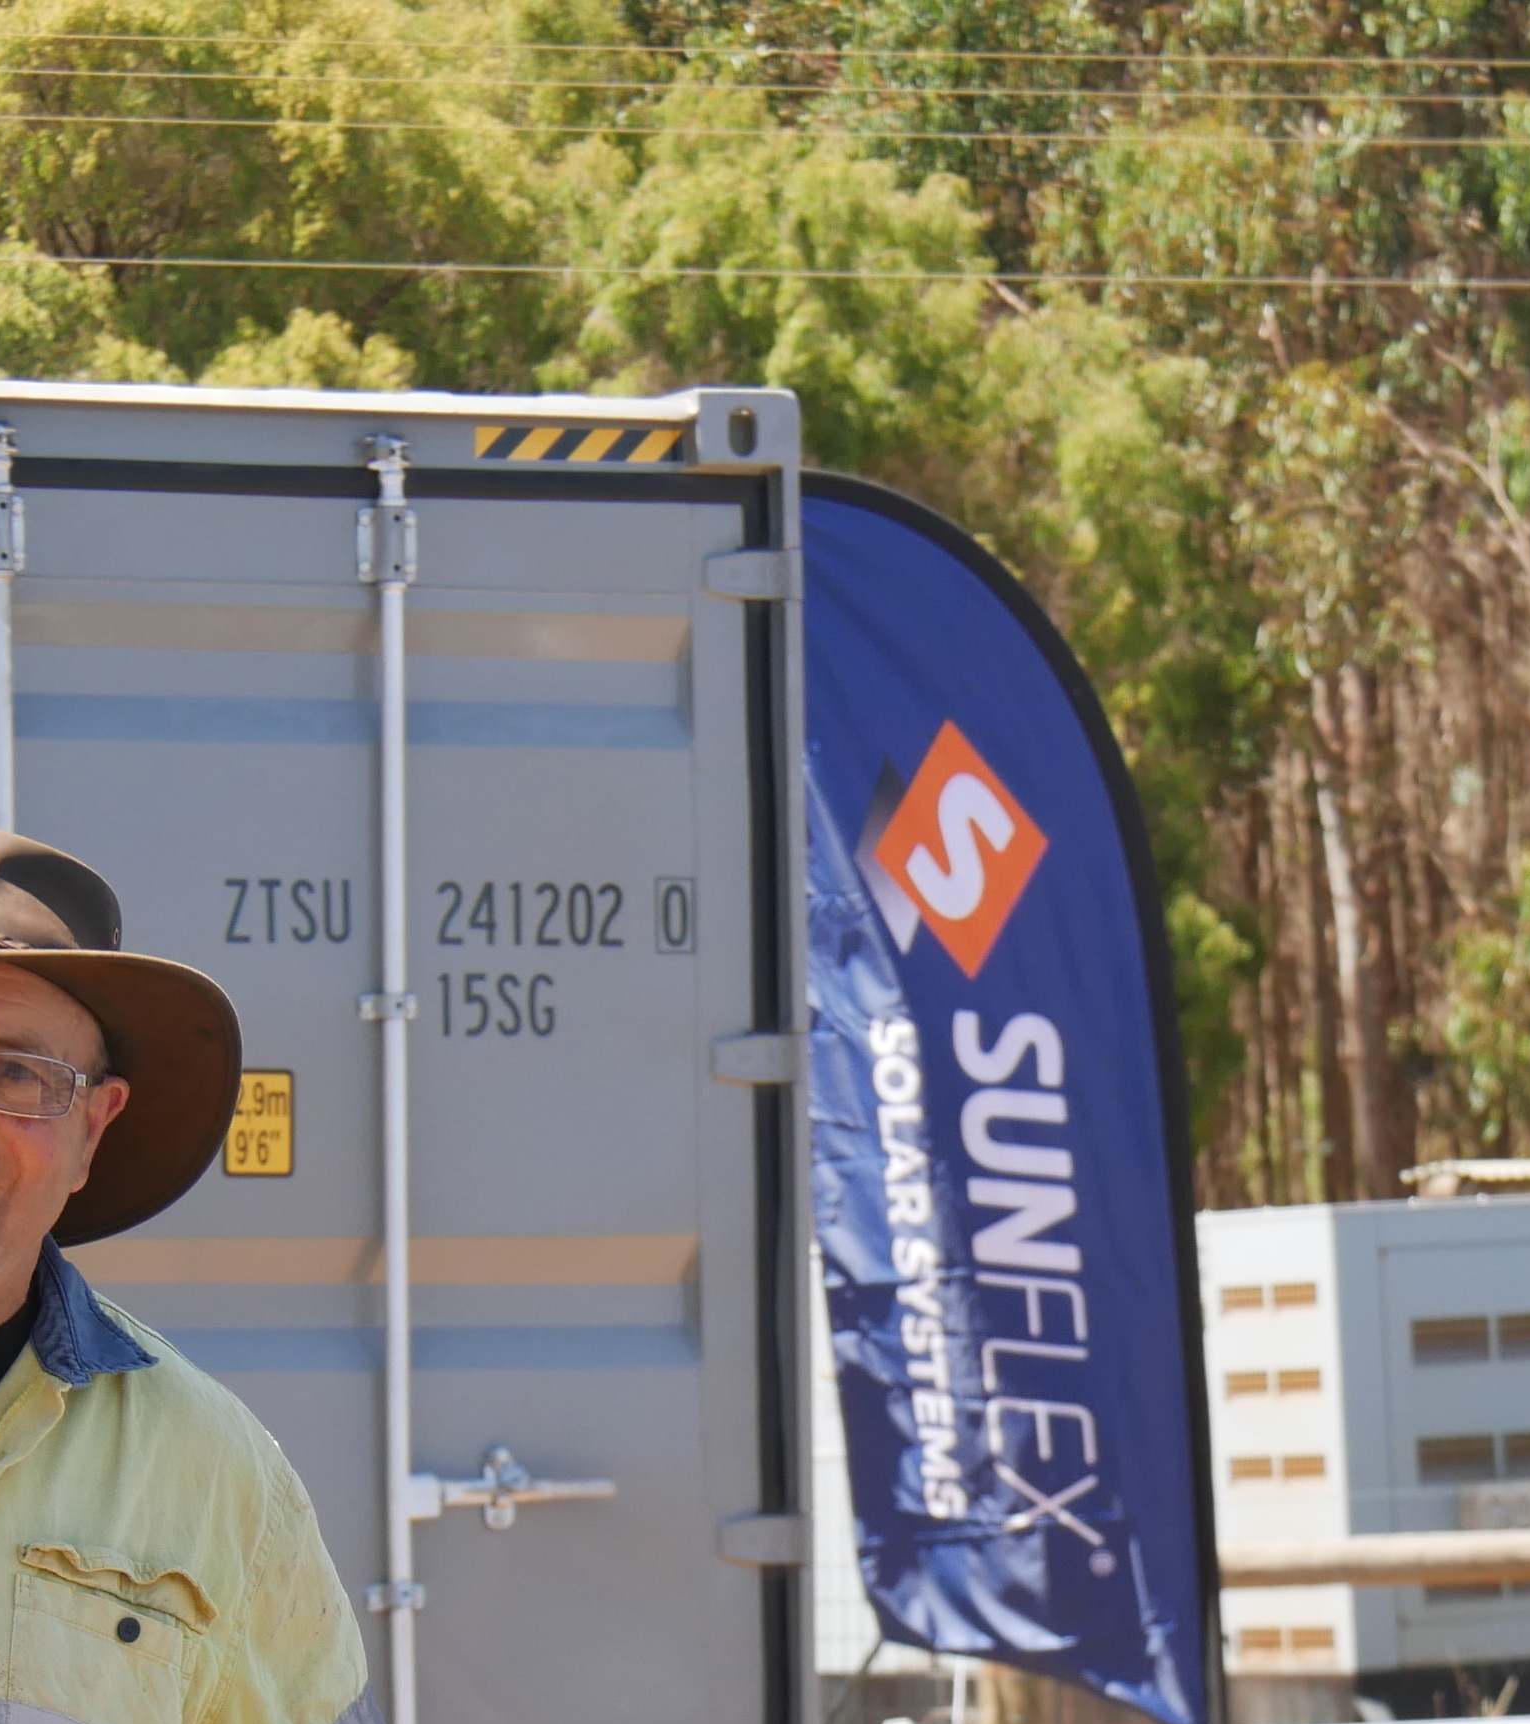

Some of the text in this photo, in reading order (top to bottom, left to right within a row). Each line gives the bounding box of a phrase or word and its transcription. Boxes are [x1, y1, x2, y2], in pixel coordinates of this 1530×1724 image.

[223, 878, 691, 949] ZTSU 241202 0
[437, 972, 557, 1038] 15SG
[869, 1017, 970, 1519] SOLAR SYSTEMS
[952, 1007, 1105, 1547] SUNFLEX
